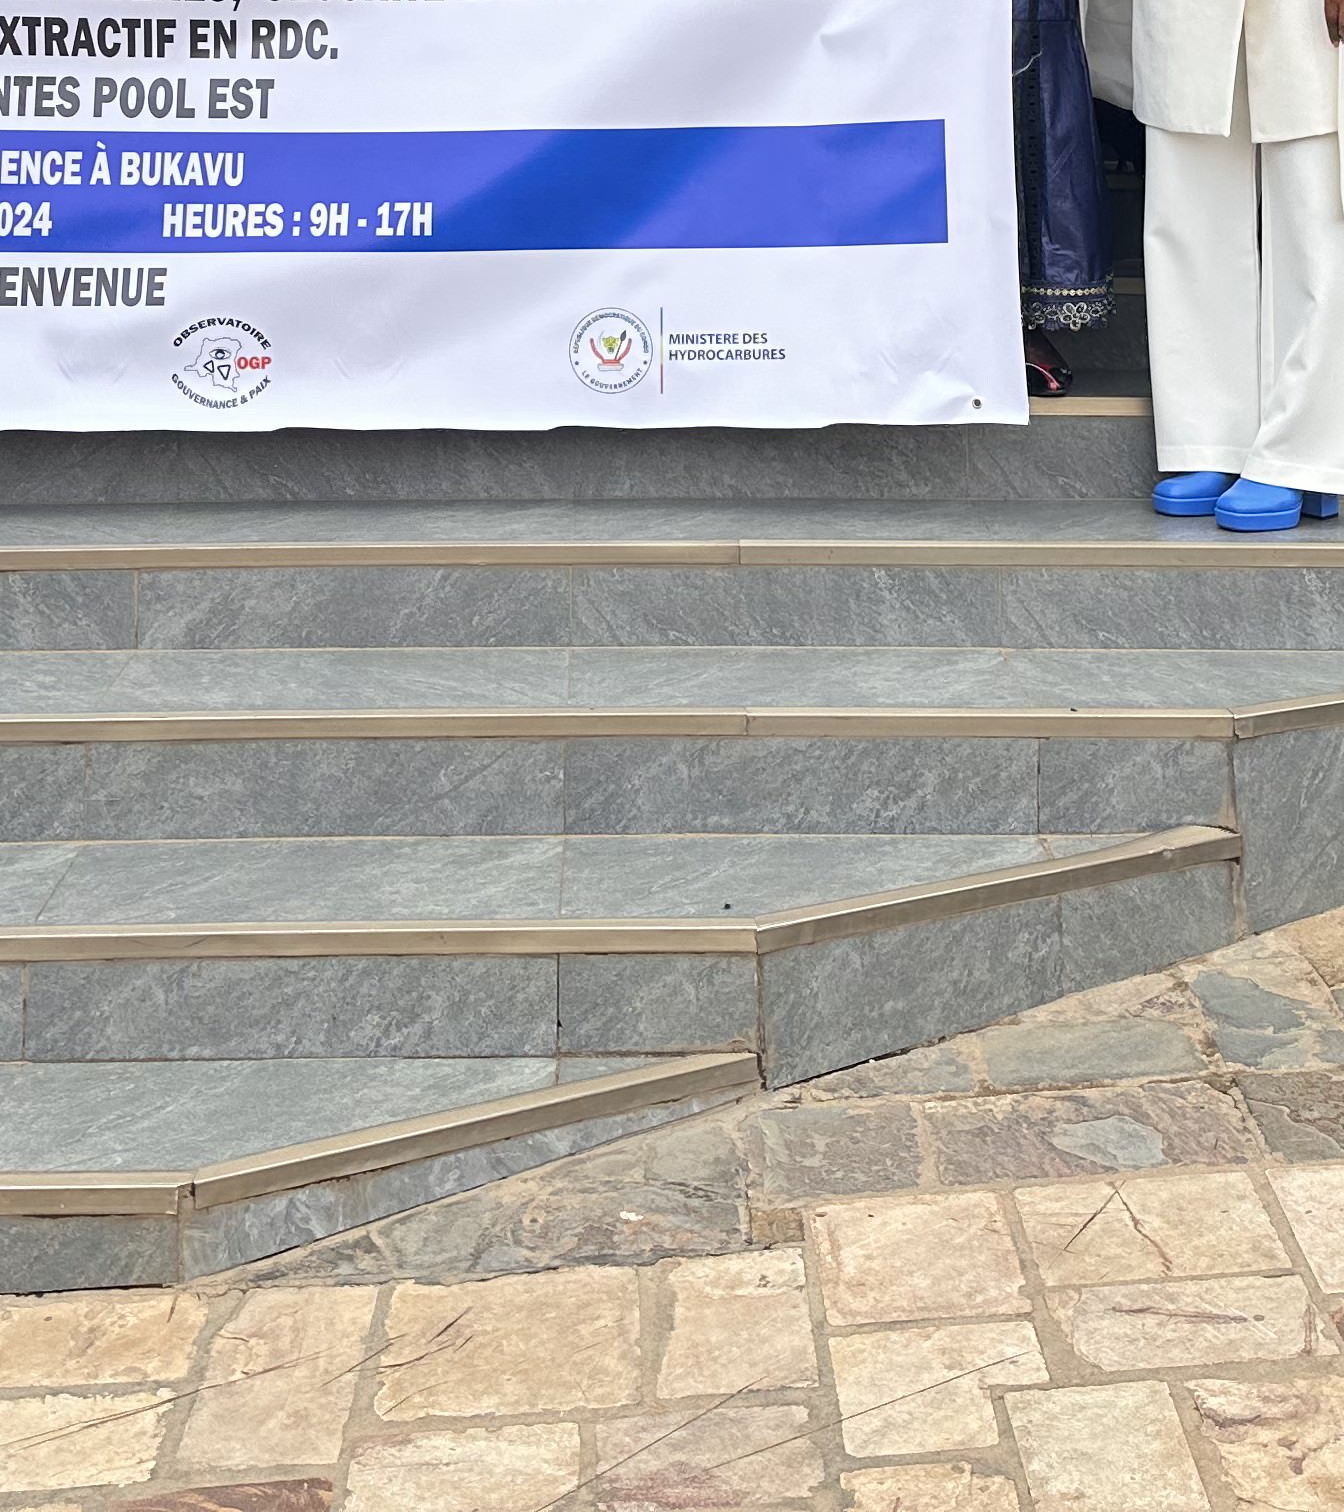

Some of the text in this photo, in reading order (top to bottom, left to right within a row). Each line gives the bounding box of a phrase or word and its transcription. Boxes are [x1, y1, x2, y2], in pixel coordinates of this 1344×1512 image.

[189, 19, 237, 59] EN
[251, 18, 339, 59] RDC.
[93, 76, 196, 119] POOL
[207, 77, 275, 119] EST
[89, 140, 112, 186] À
[119, 151, 246, 187] BUKAVU
[162, 202, 284, 238] HEURES
[292, 209, 302, 237] :
[309, 202, 350, 237] 9H
[375, 201, 434, 237] 17H
[173, 317, 272, 350] OBSERVATOIRE
[668, 333, 768, 345] MINISTERE DES
[237, 356, 272, 369] OGP
[668, 348, 786, 361] HYDROCARBURES
[171, 373, 271, 409] GOUVERNANCE & PAIX
